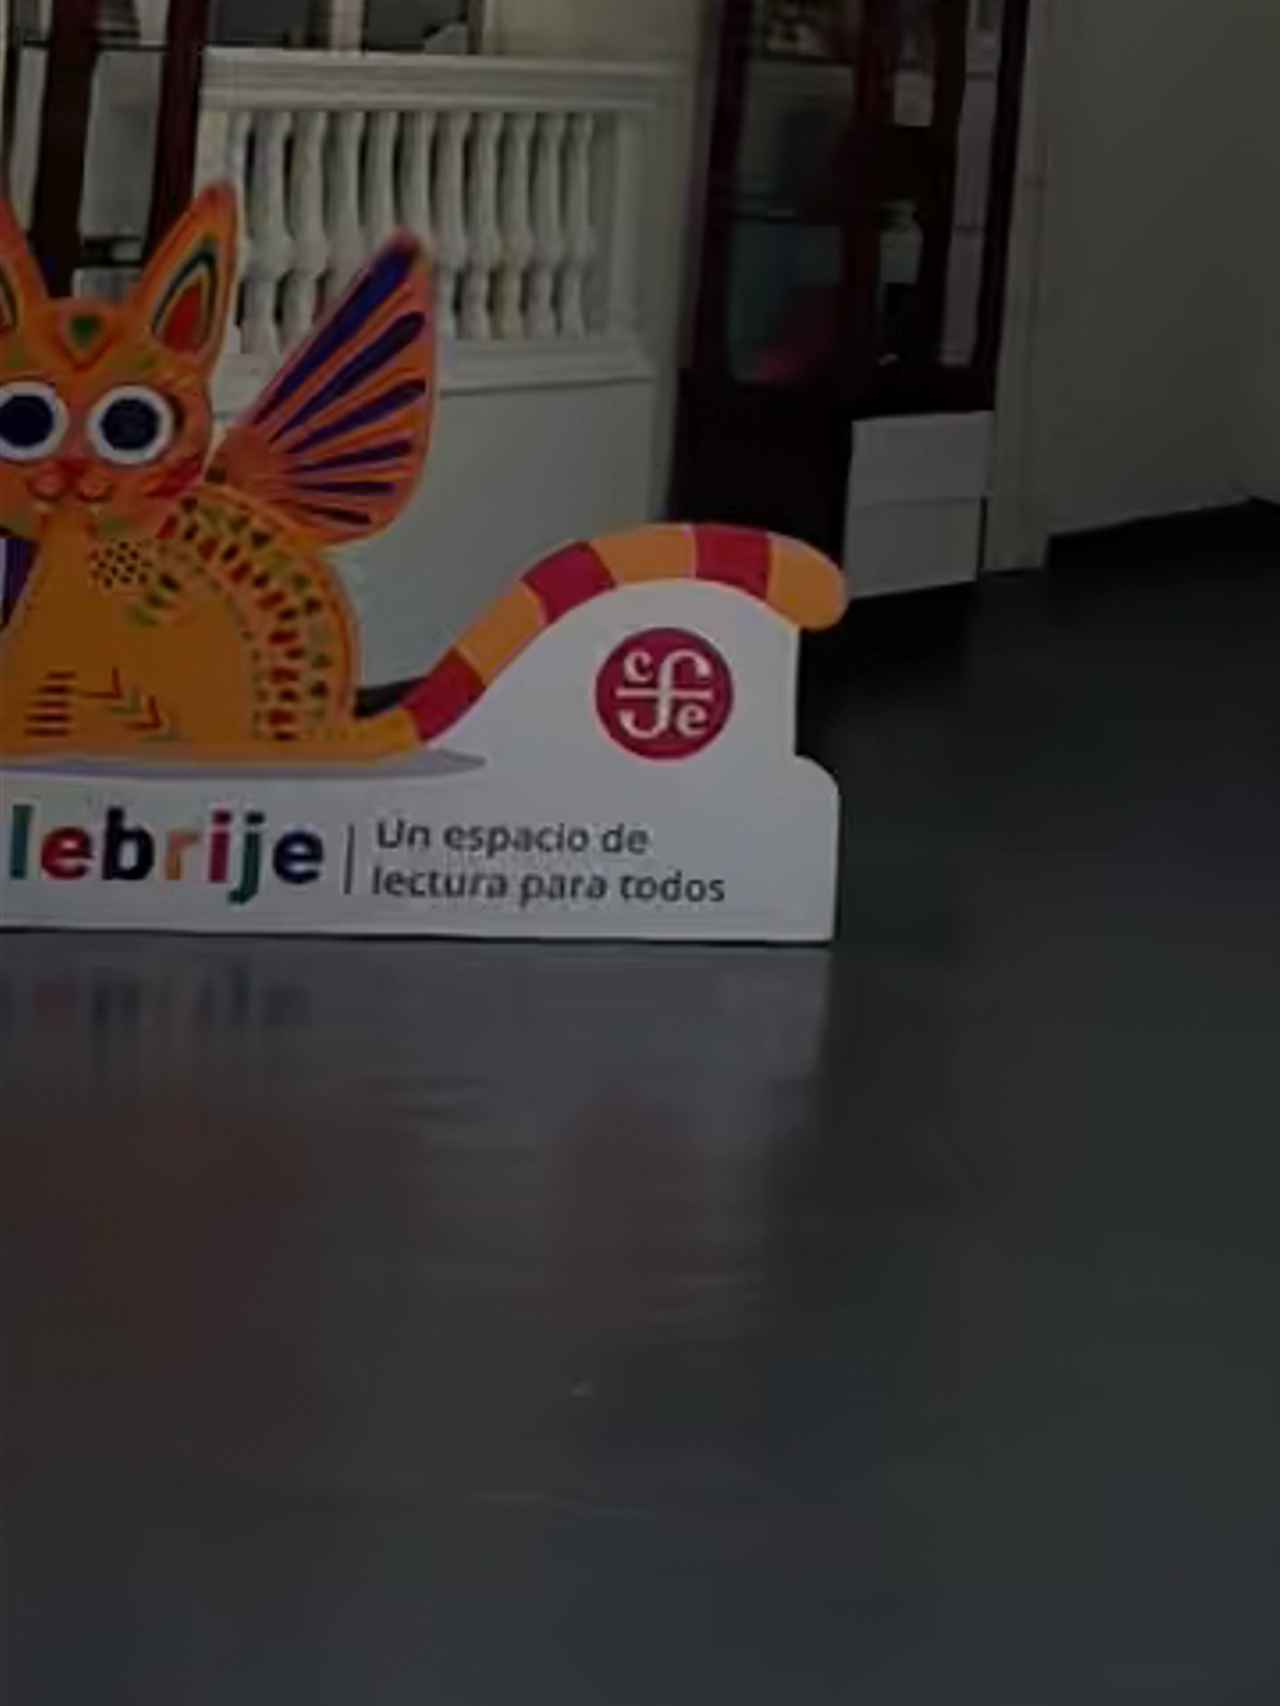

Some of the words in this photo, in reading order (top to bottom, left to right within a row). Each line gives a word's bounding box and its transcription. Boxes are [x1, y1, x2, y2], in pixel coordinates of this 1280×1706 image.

[10, 804, 324, 905] lebrije
[376, 818, 430, 848] Un
[444, 822, 590, 858] espacio
[602, 823, 649, 854] de
[371, 865, 507, 899] lectura
[520, 872, 606, 907] para
[620, 870, 725, 902] todos
